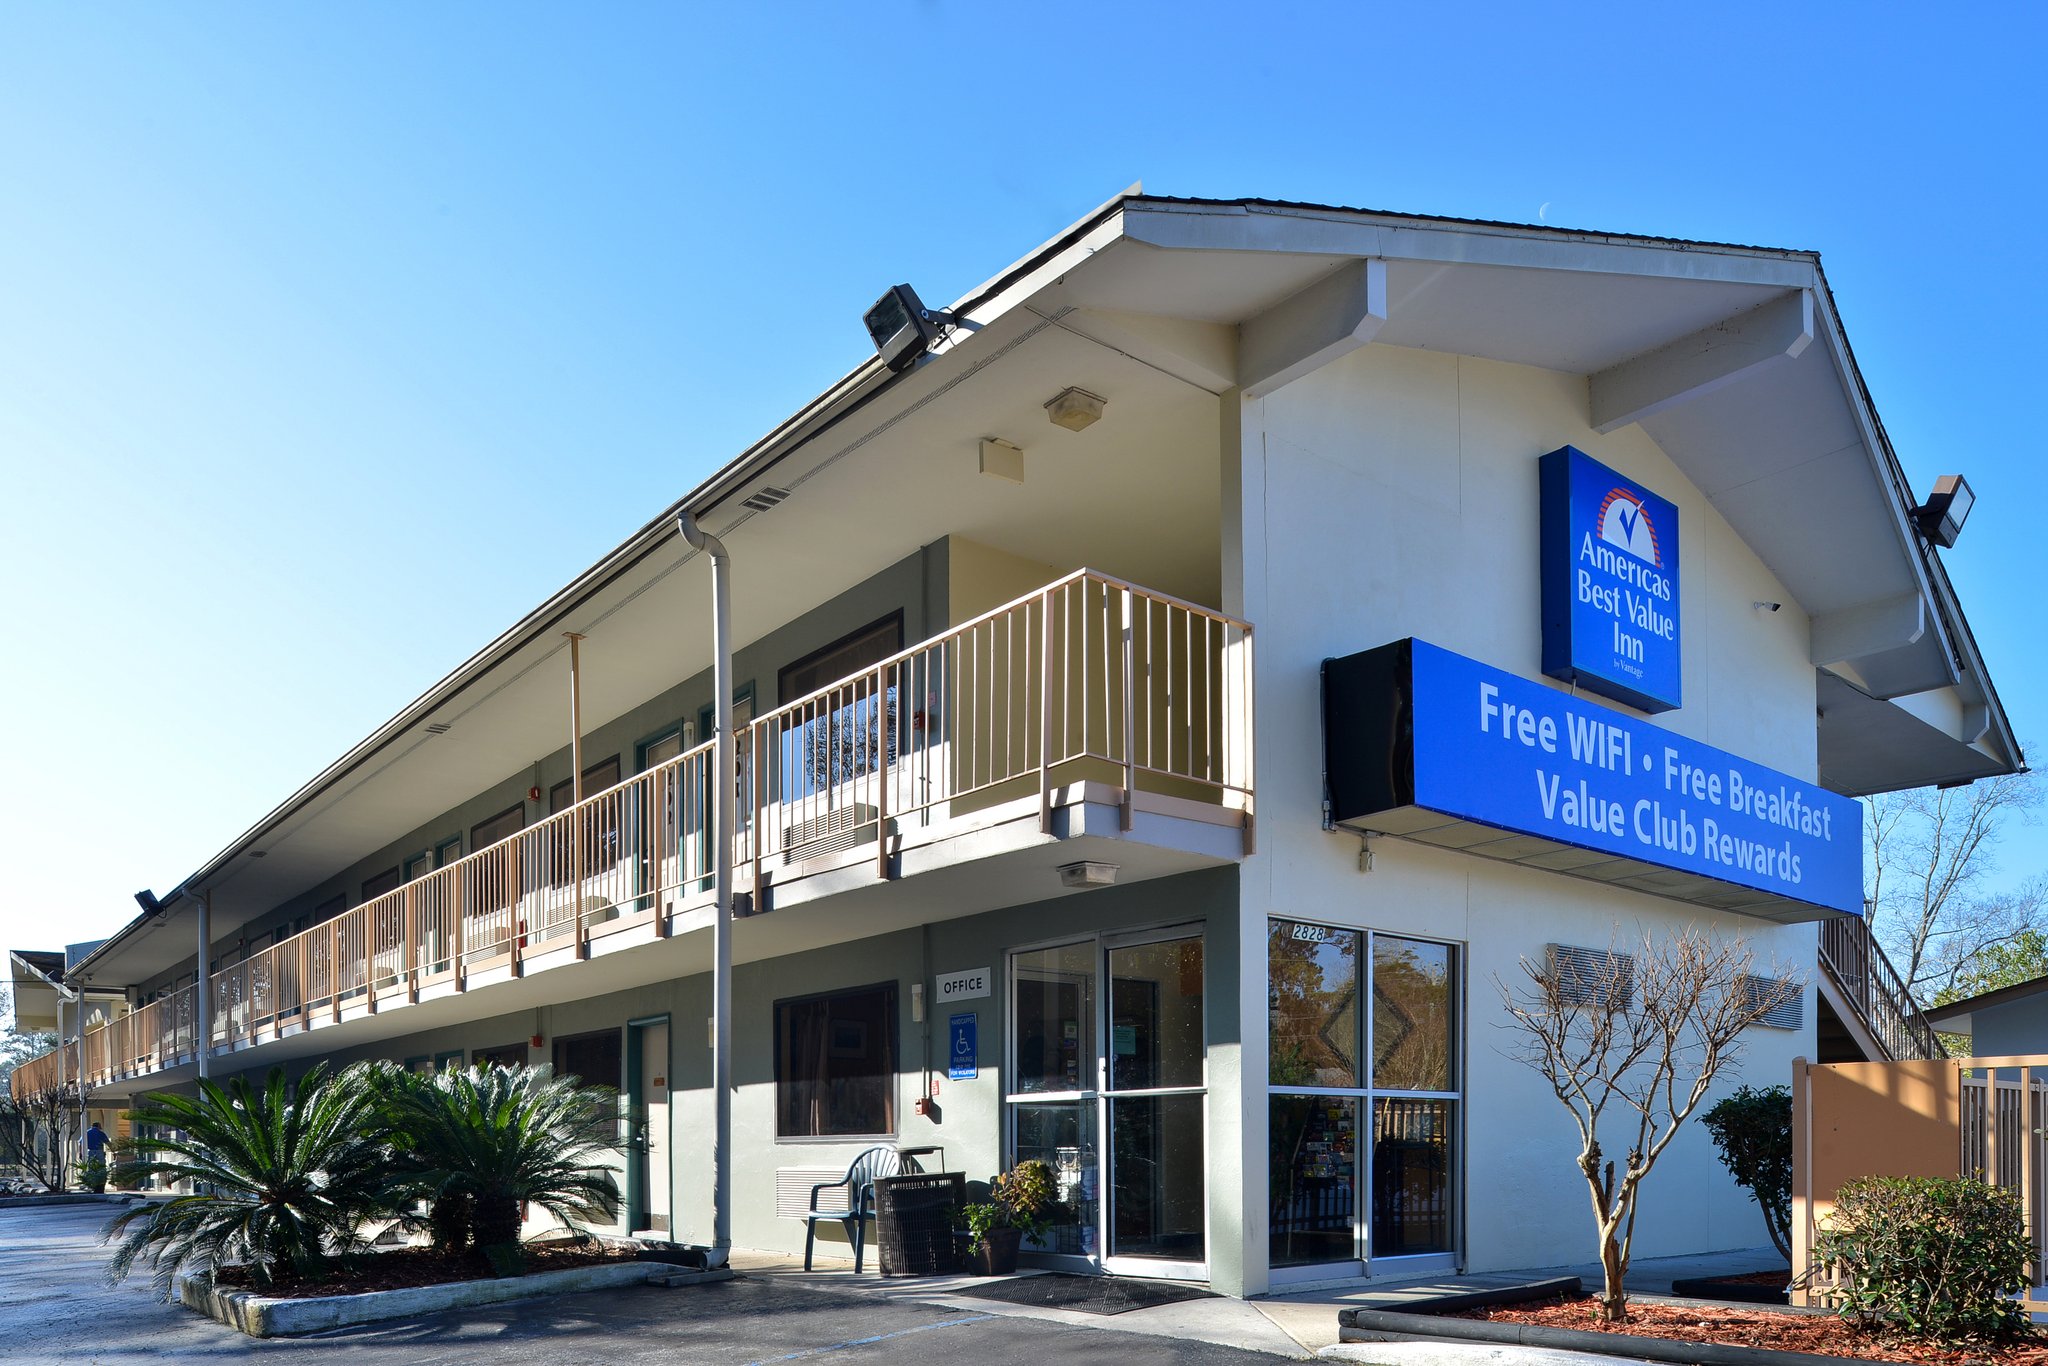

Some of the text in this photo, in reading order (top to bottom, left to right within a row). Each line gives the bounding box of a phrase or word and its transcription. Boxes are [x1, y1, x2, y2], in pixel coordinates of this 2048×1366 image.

[1580, 531, 1670, 602] Americas
[1578, 568, 1674, 641] Best Value
[1613, 658, 1644, 680] by Vantage
[1614, 621, 1644, 663] Inn
[1480, 681, 1832, 842] Free WIFI Free Breakfast
[1536, 769, 1802, 885] Value Club Rewards
[1293, 925, 1324, 941] 2828
[943, 977, 983, 994] OFFICE
